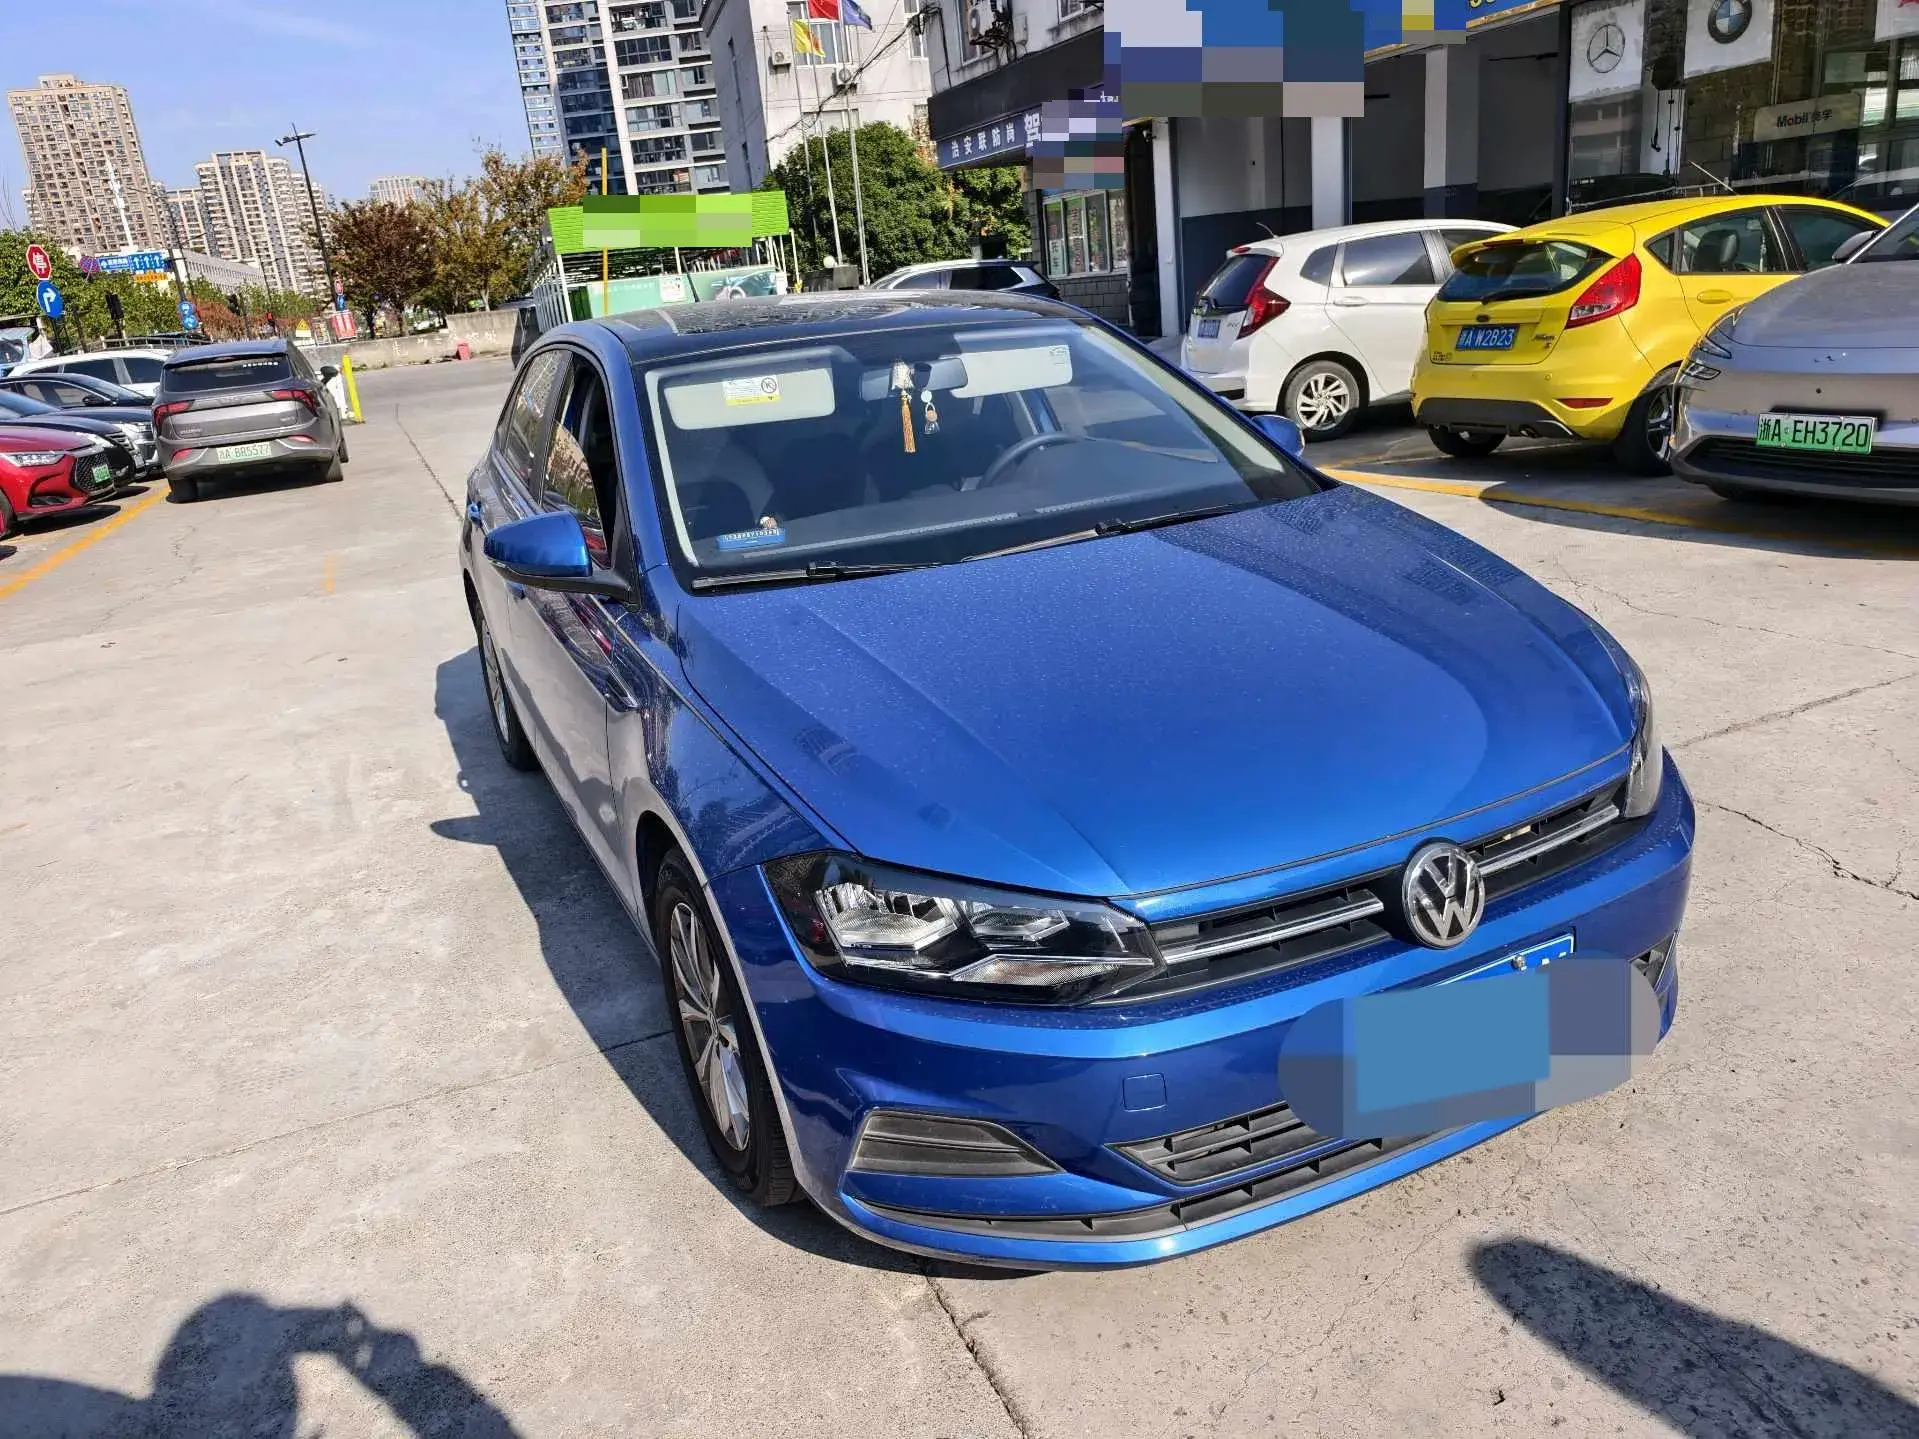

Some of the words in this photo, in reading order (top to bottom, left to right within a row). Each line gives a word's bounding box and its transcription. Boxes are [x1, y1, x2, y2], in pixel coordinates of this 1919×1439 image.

[1777, 112, 1808, 128] Mobil
[951, 121, 1015, 159] 治安联防岗
[32, 251, 48, 275] 停
